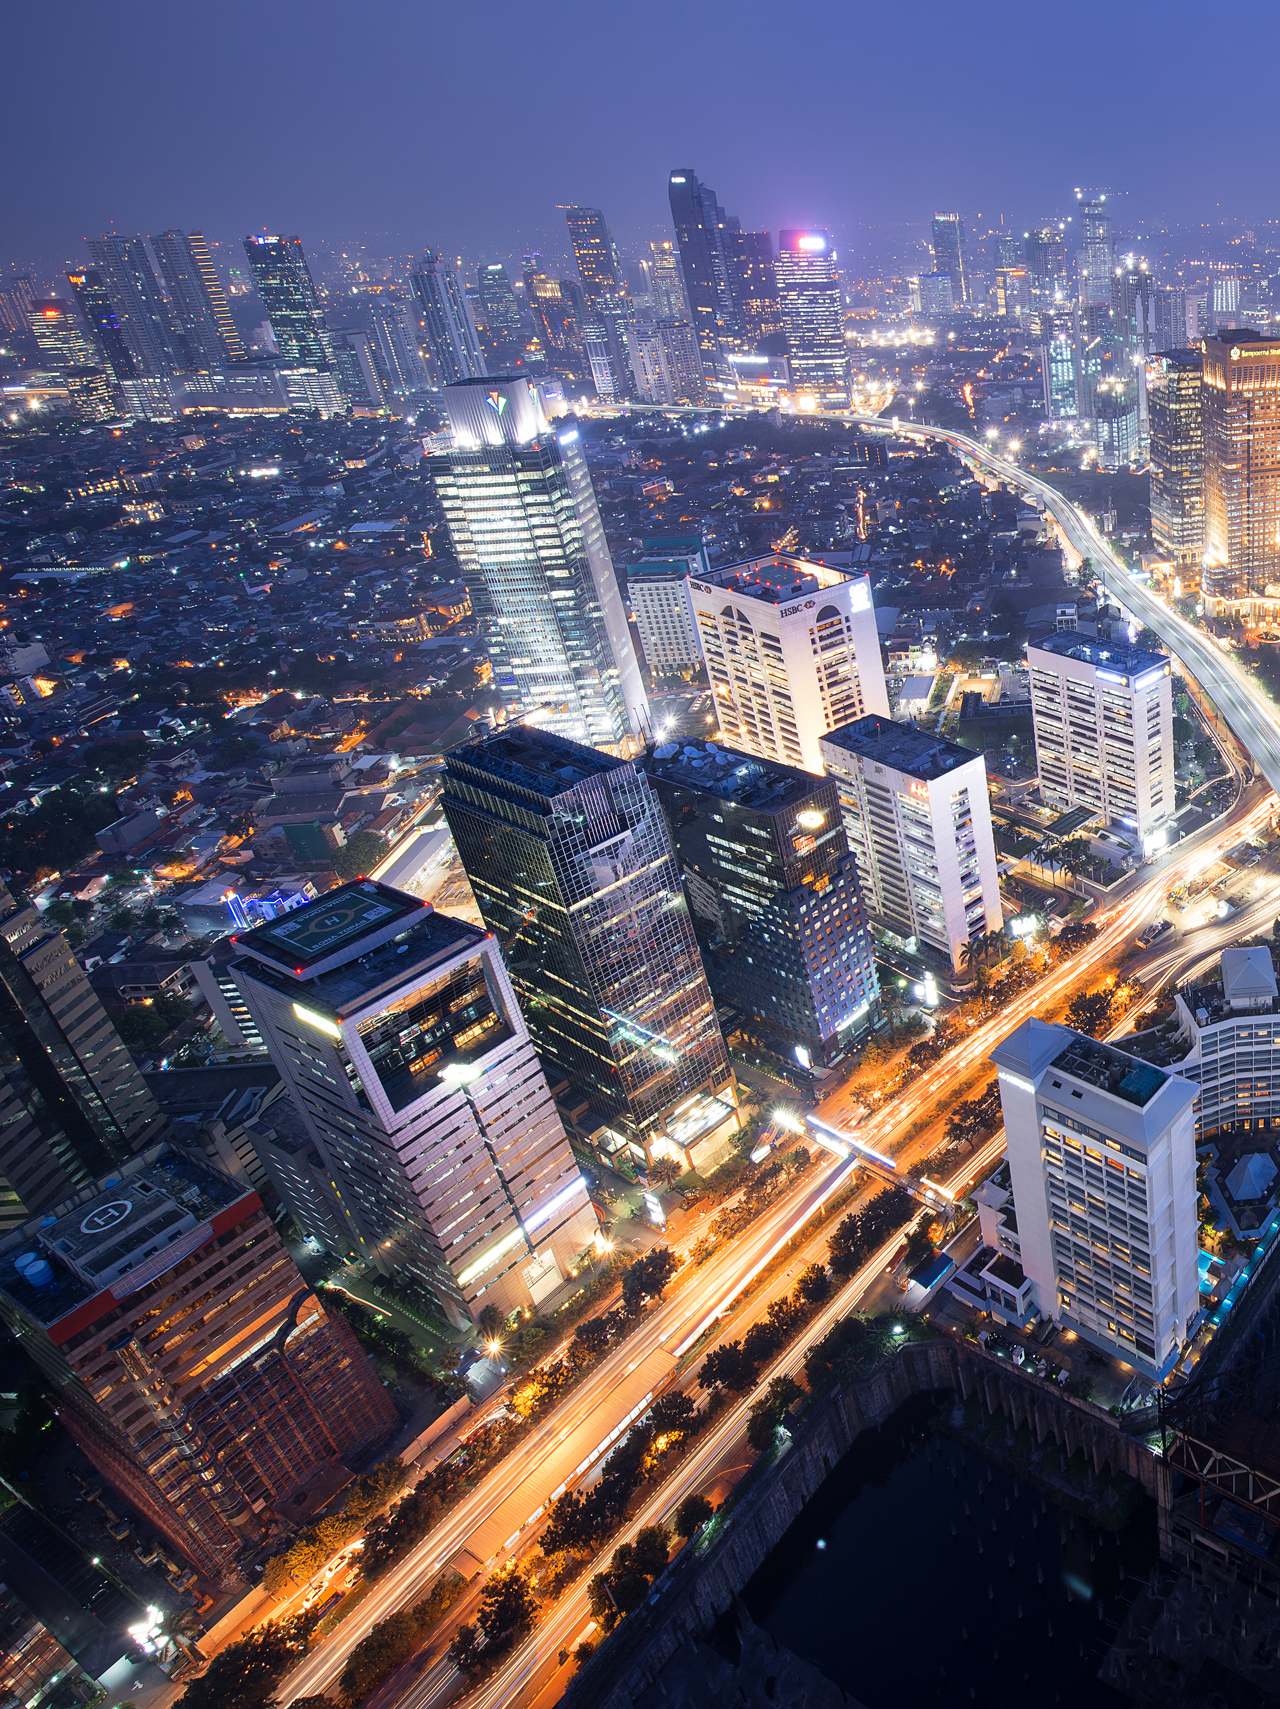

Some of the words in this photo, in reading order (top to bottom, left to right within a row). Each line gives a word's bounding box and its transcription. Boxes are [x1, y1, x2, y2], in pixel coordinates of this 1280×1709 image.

[1241, 349, 1269, 358] Sampoerna
[689, 580, 704, 593] HSBC
[780, 604, 803, 618] HSBC
[324, 916, 340, 926] H
[338, 919, 367, 938] TOPAS
[93, 1207, 120, 1226] H
